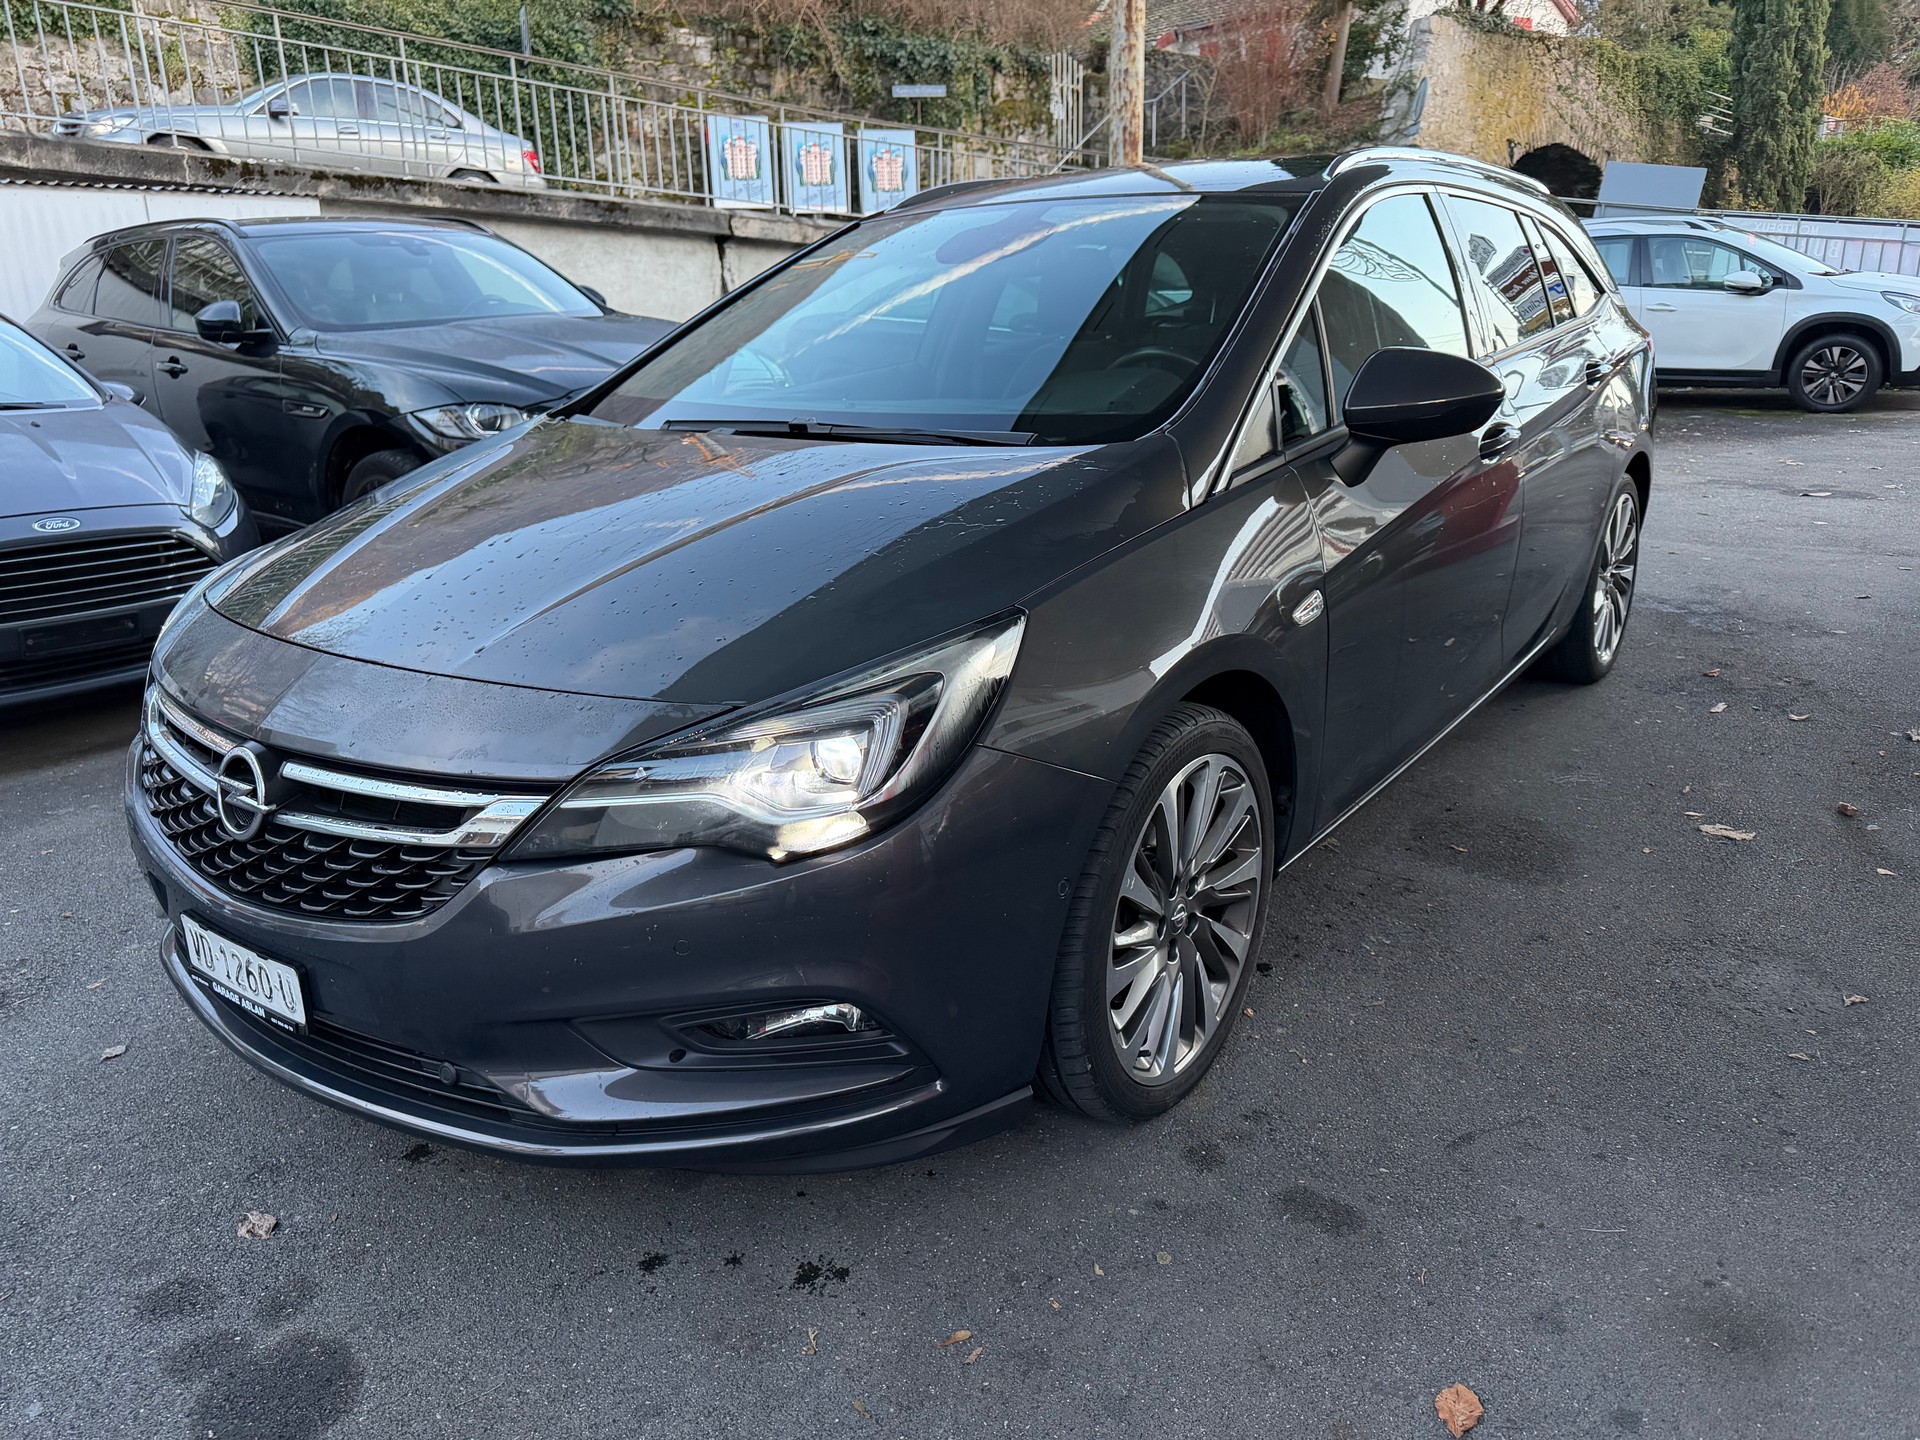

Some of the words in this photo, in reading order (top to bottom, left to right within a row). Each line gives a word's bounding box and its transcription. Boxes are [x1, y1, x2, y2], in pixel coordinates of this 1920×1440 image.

[45, 520, 71, 530] Ford
[212, 981, 241, 1005] GARAGE
[241, 997, 266, 1018] ASLAN
